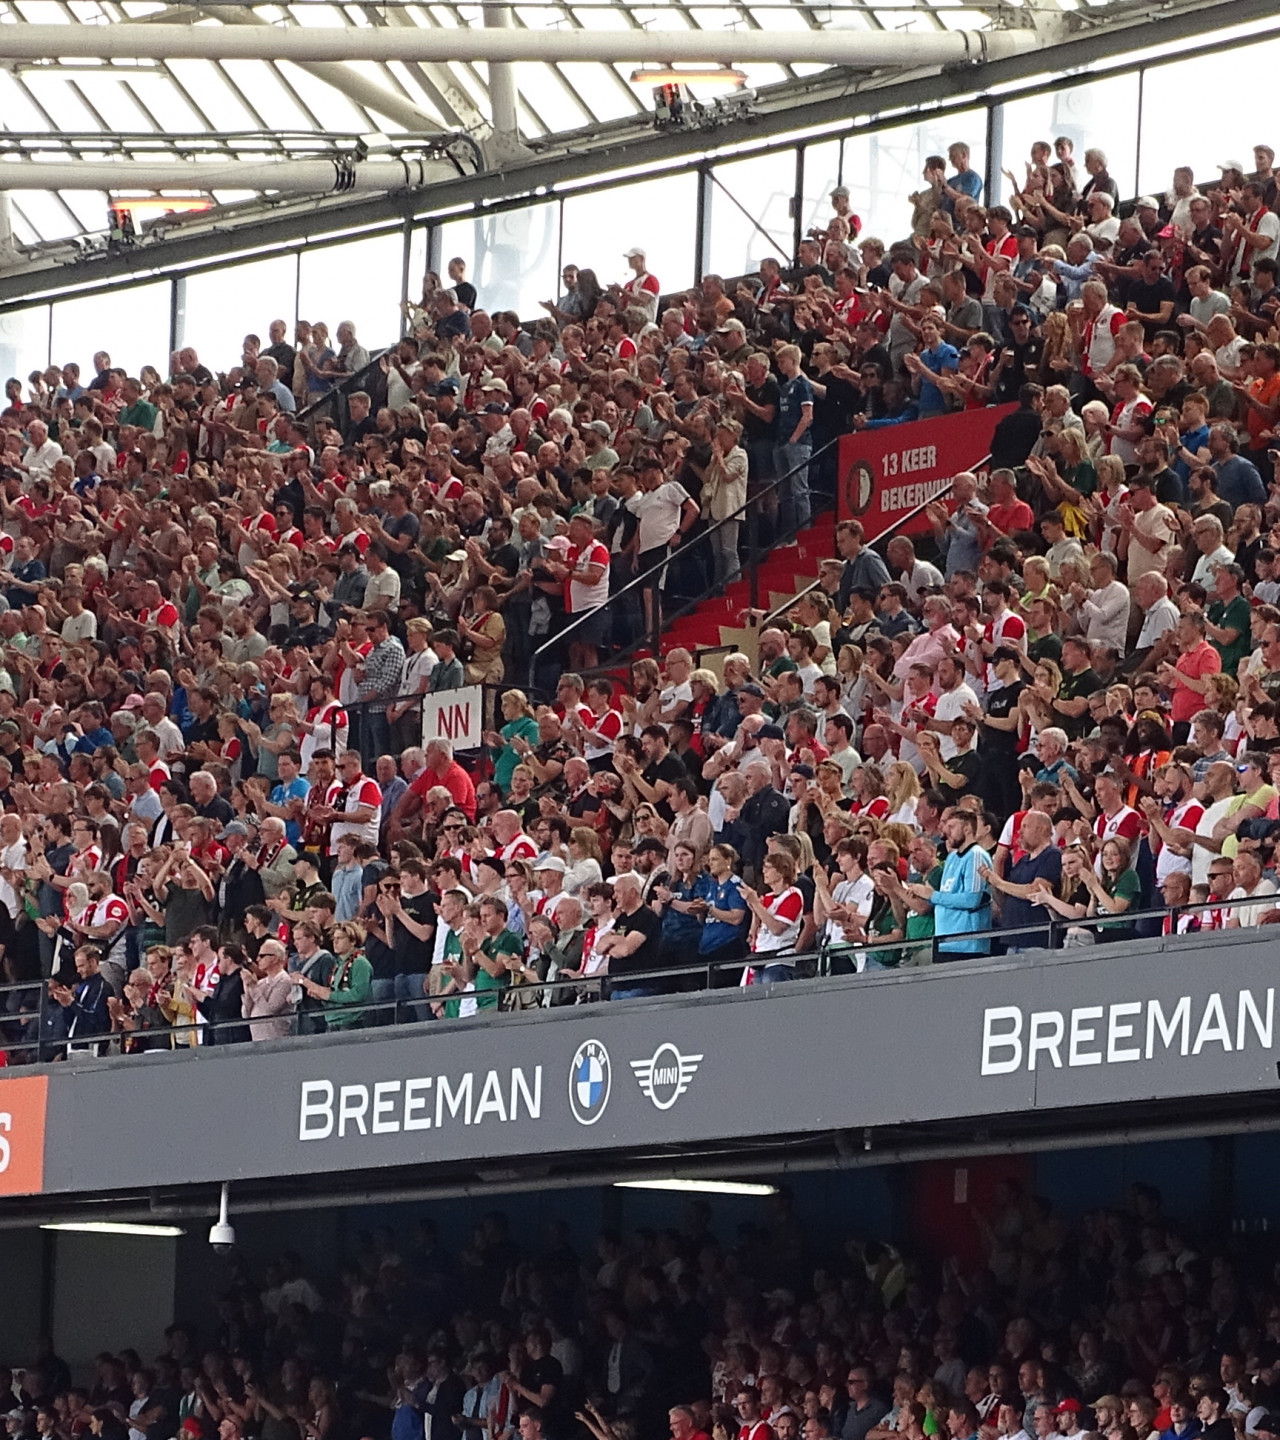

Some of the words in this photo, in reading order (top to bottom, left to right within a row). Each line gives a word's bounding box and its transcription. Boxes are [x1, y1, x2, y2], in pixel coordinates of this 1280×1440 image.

[881, 452, 898, 477] 13
[901, 445, 937, 474] KEER
[438, 702, 470, 740] NN
[981, 988, 1276, 1077] BREEMAN
[653, 1066, 678, 1085] MINI
[299, 1065, 543, 1141] BREEMAN
